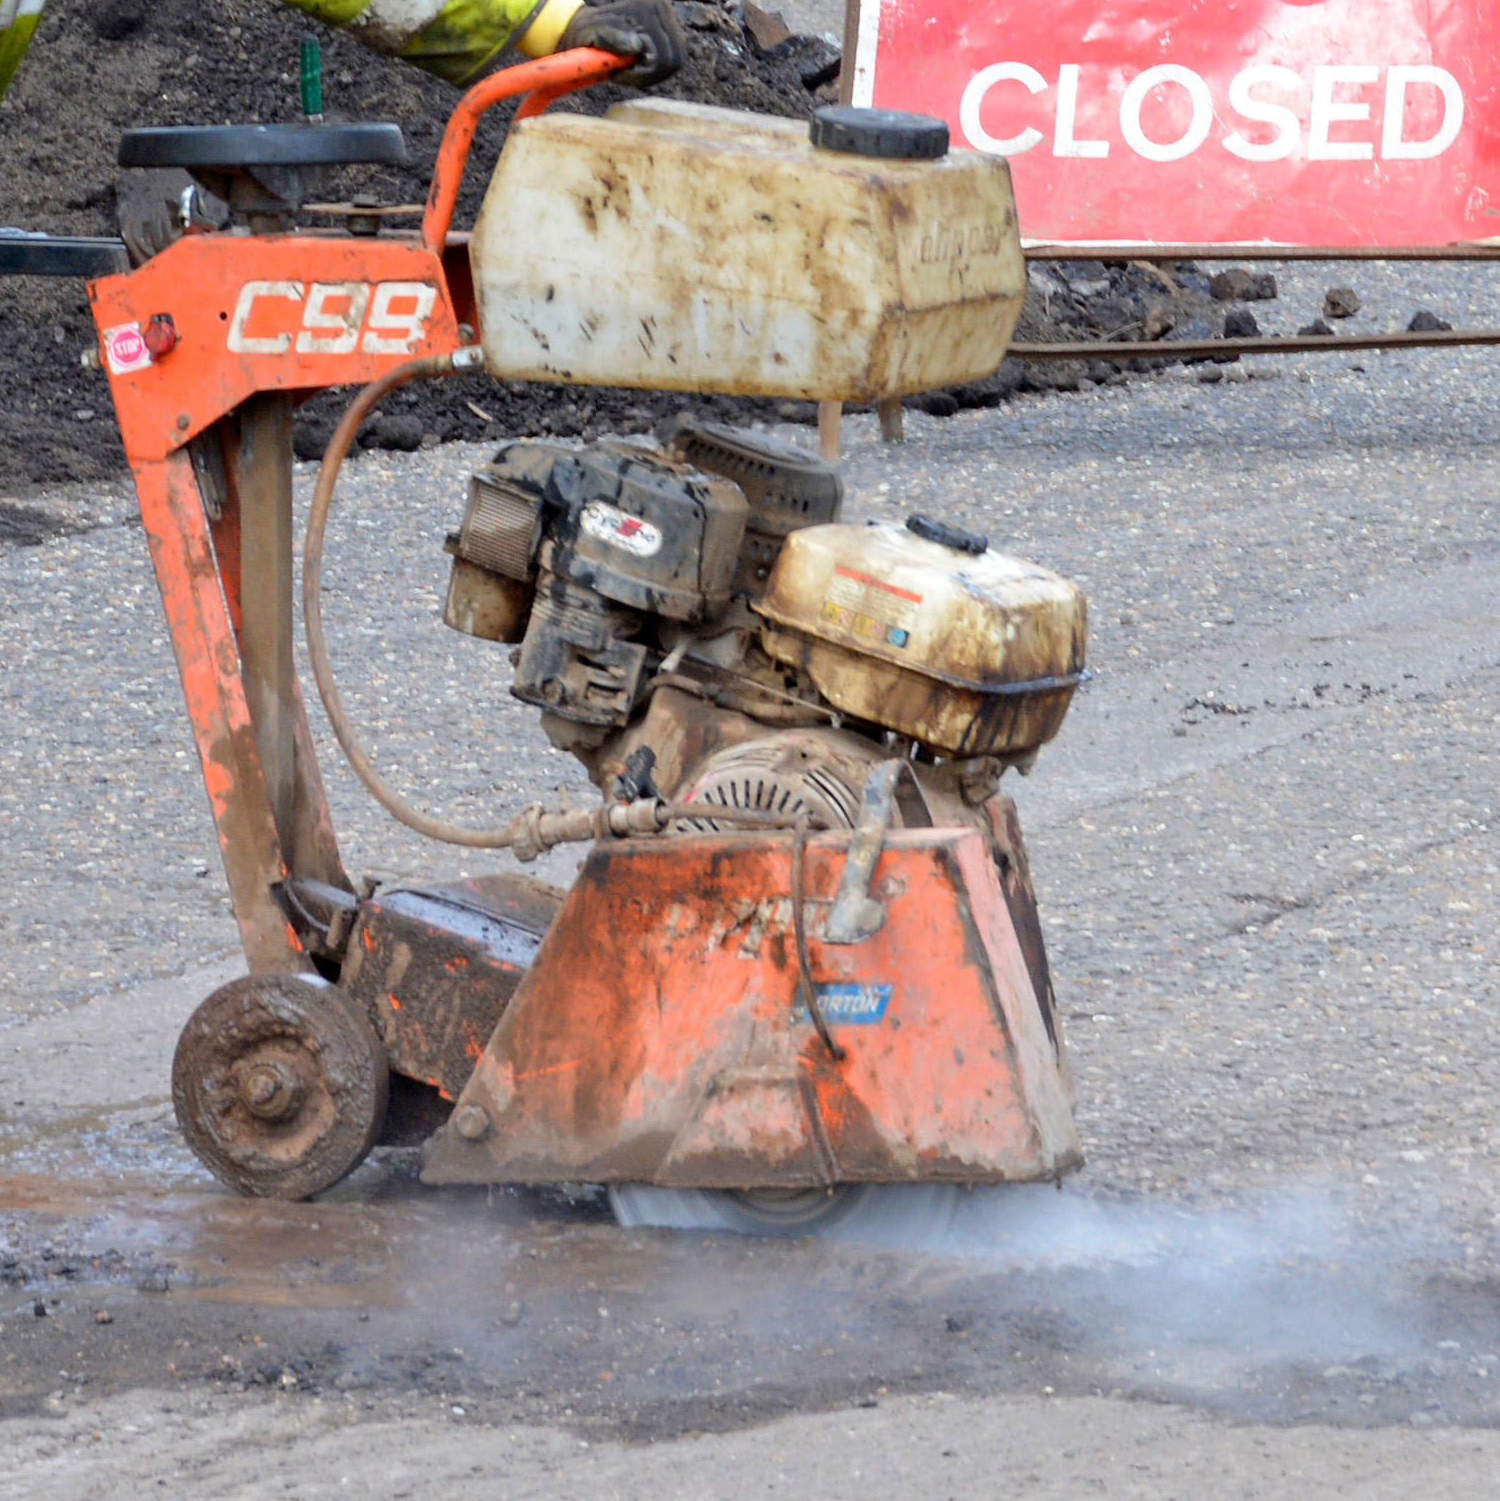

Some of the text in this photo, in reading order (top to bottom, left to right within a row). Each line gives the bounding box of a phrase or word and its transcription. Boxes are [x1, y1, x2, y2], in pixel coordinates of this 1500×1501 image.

[959, 60, 1465, 163] CLOSED
[114, 337, 140, 357] STOP
[227, 280, 437, 354] C99
